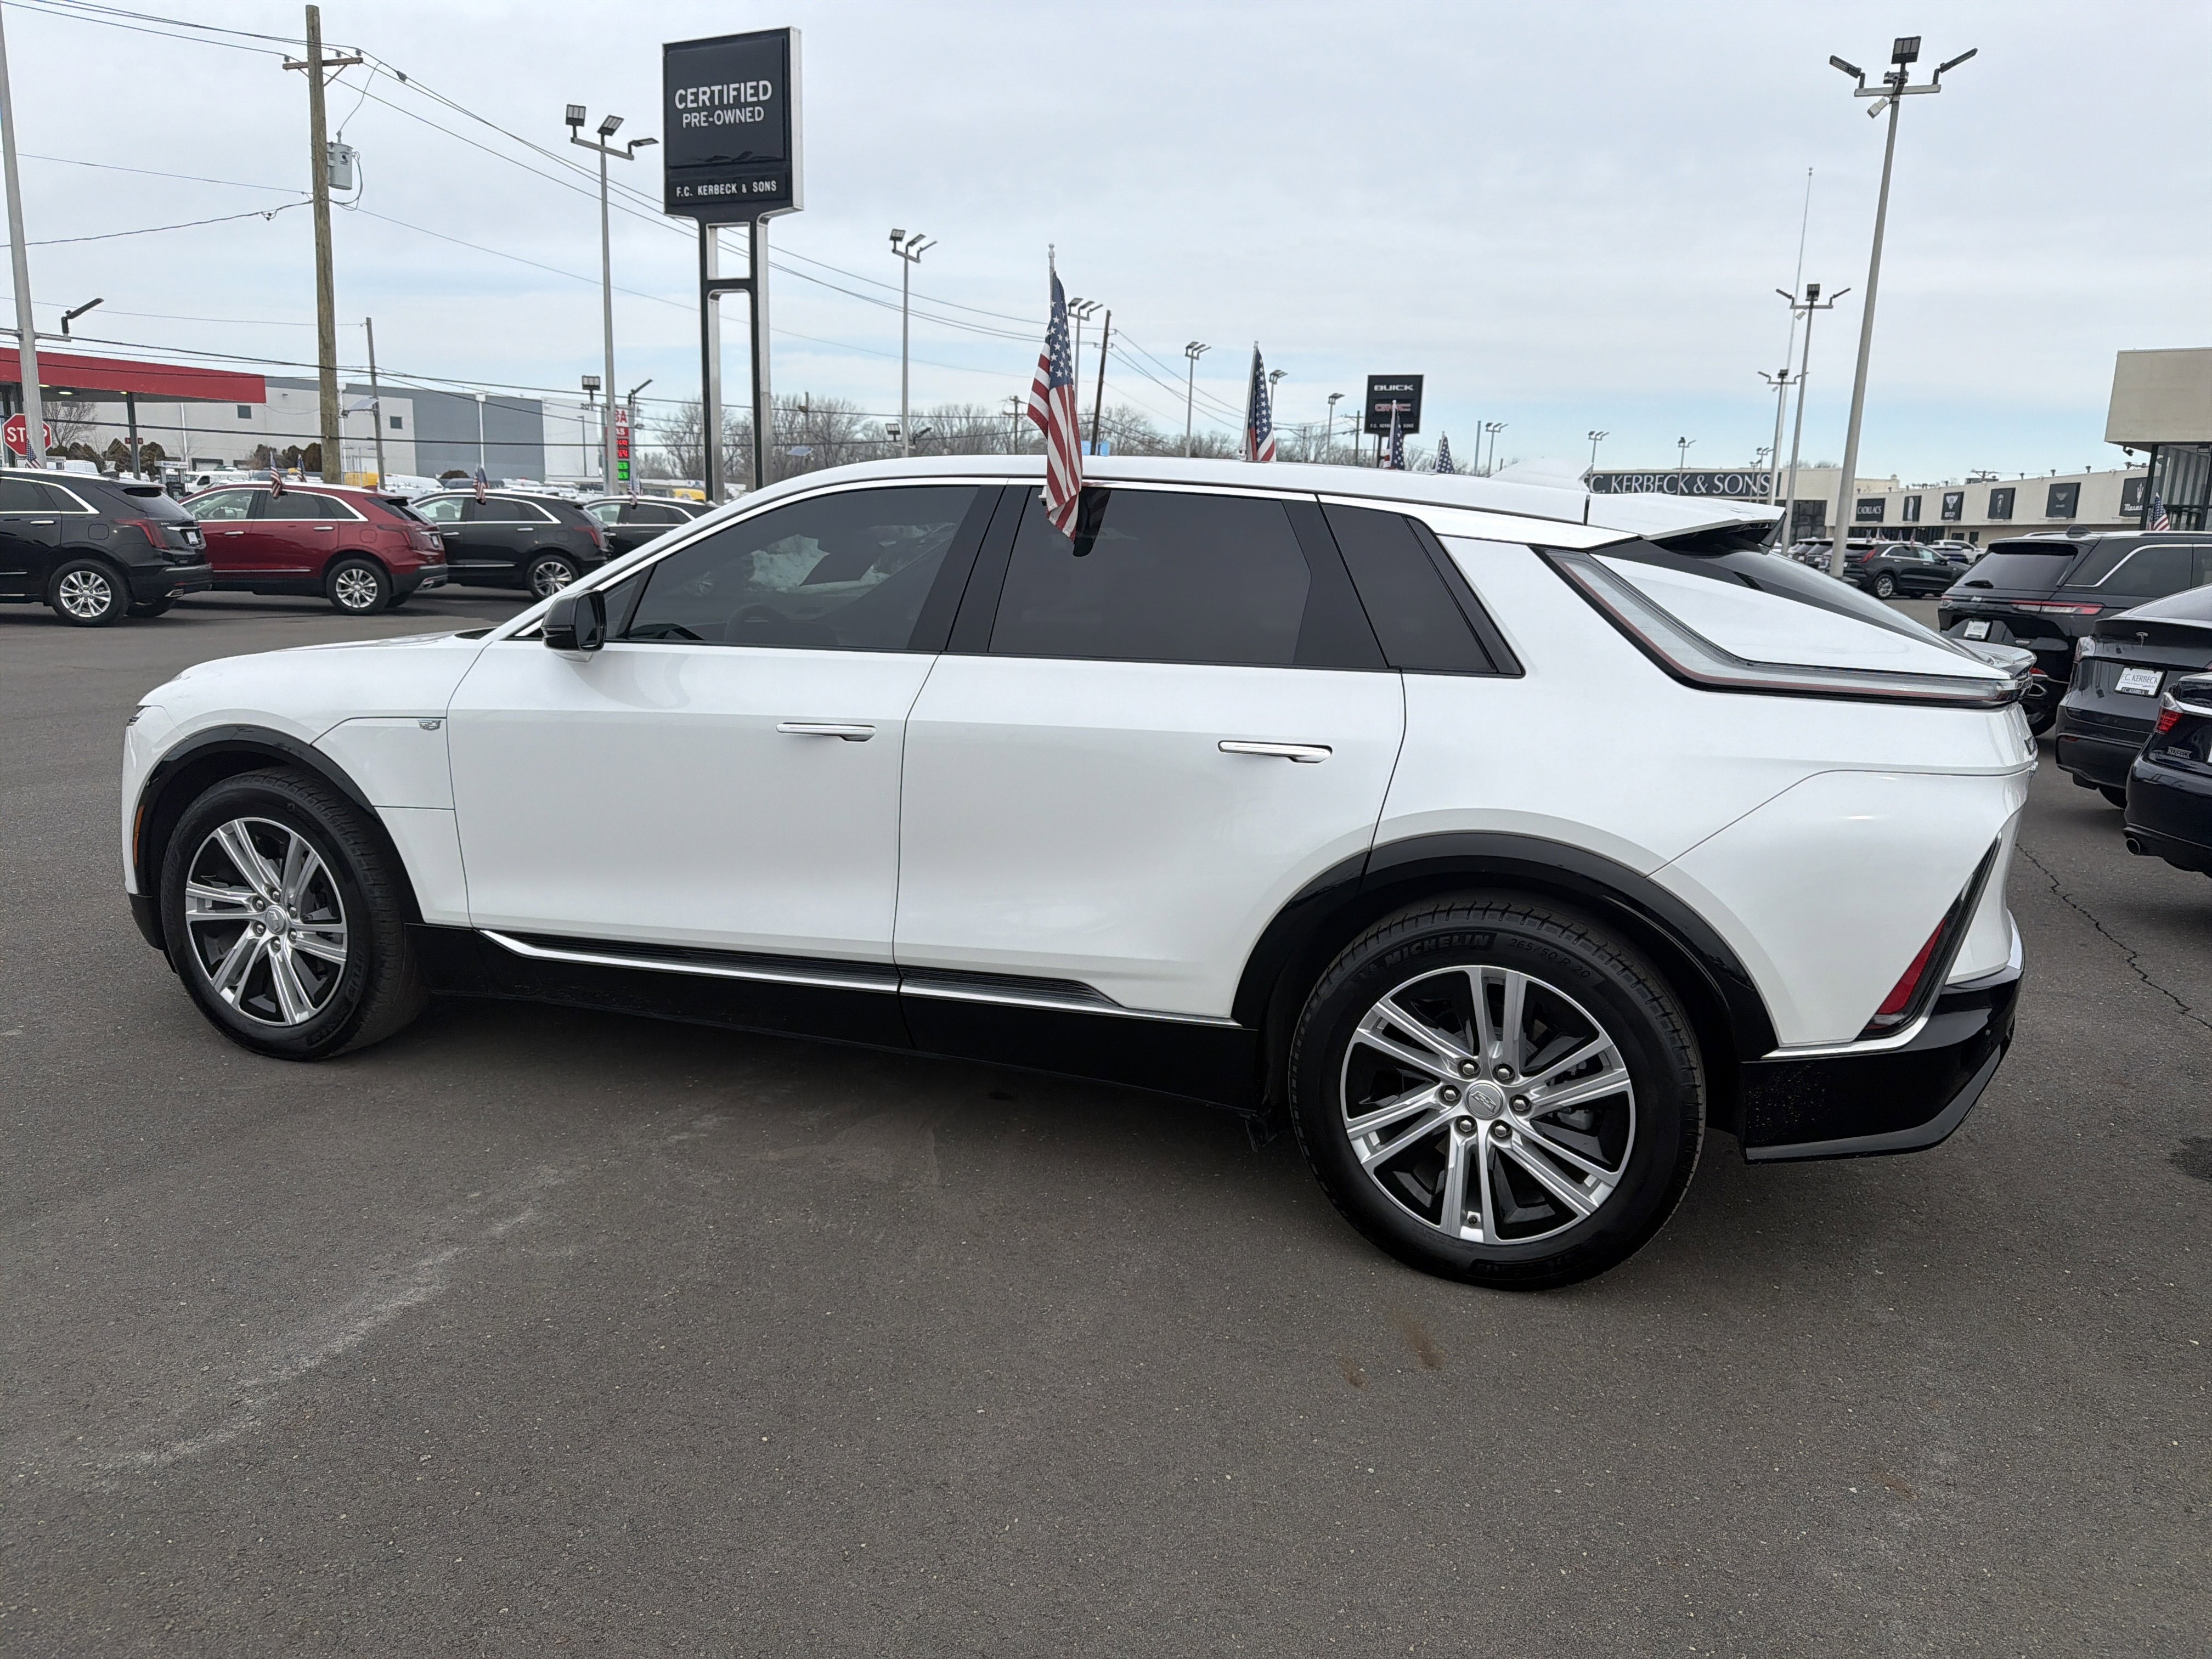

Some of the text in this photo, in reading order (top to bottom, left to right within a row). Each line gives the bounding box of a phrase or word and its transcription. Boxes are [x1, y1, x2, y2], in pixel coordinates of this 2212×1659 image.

[675, 80, 772, 109] CERTIFIED
[682, 106, 764, 128] PRE-OWNED
[676, 180, 777, 197] F.C. KERBECK & SONS
[7, 427, 48, 443] STP
[1611, 474, 1690, 494] KERBECK
[1693, 474, 1708, 494] &
[1712, 473, 1771, 494] SONS
[2131, 674, 2158, 684] KERBECK
[1384, 934, 1489, 968] MICHELIN
[1509, 938, 1558, 960] 265/50
[1573, 965, 1590, 978] 20
